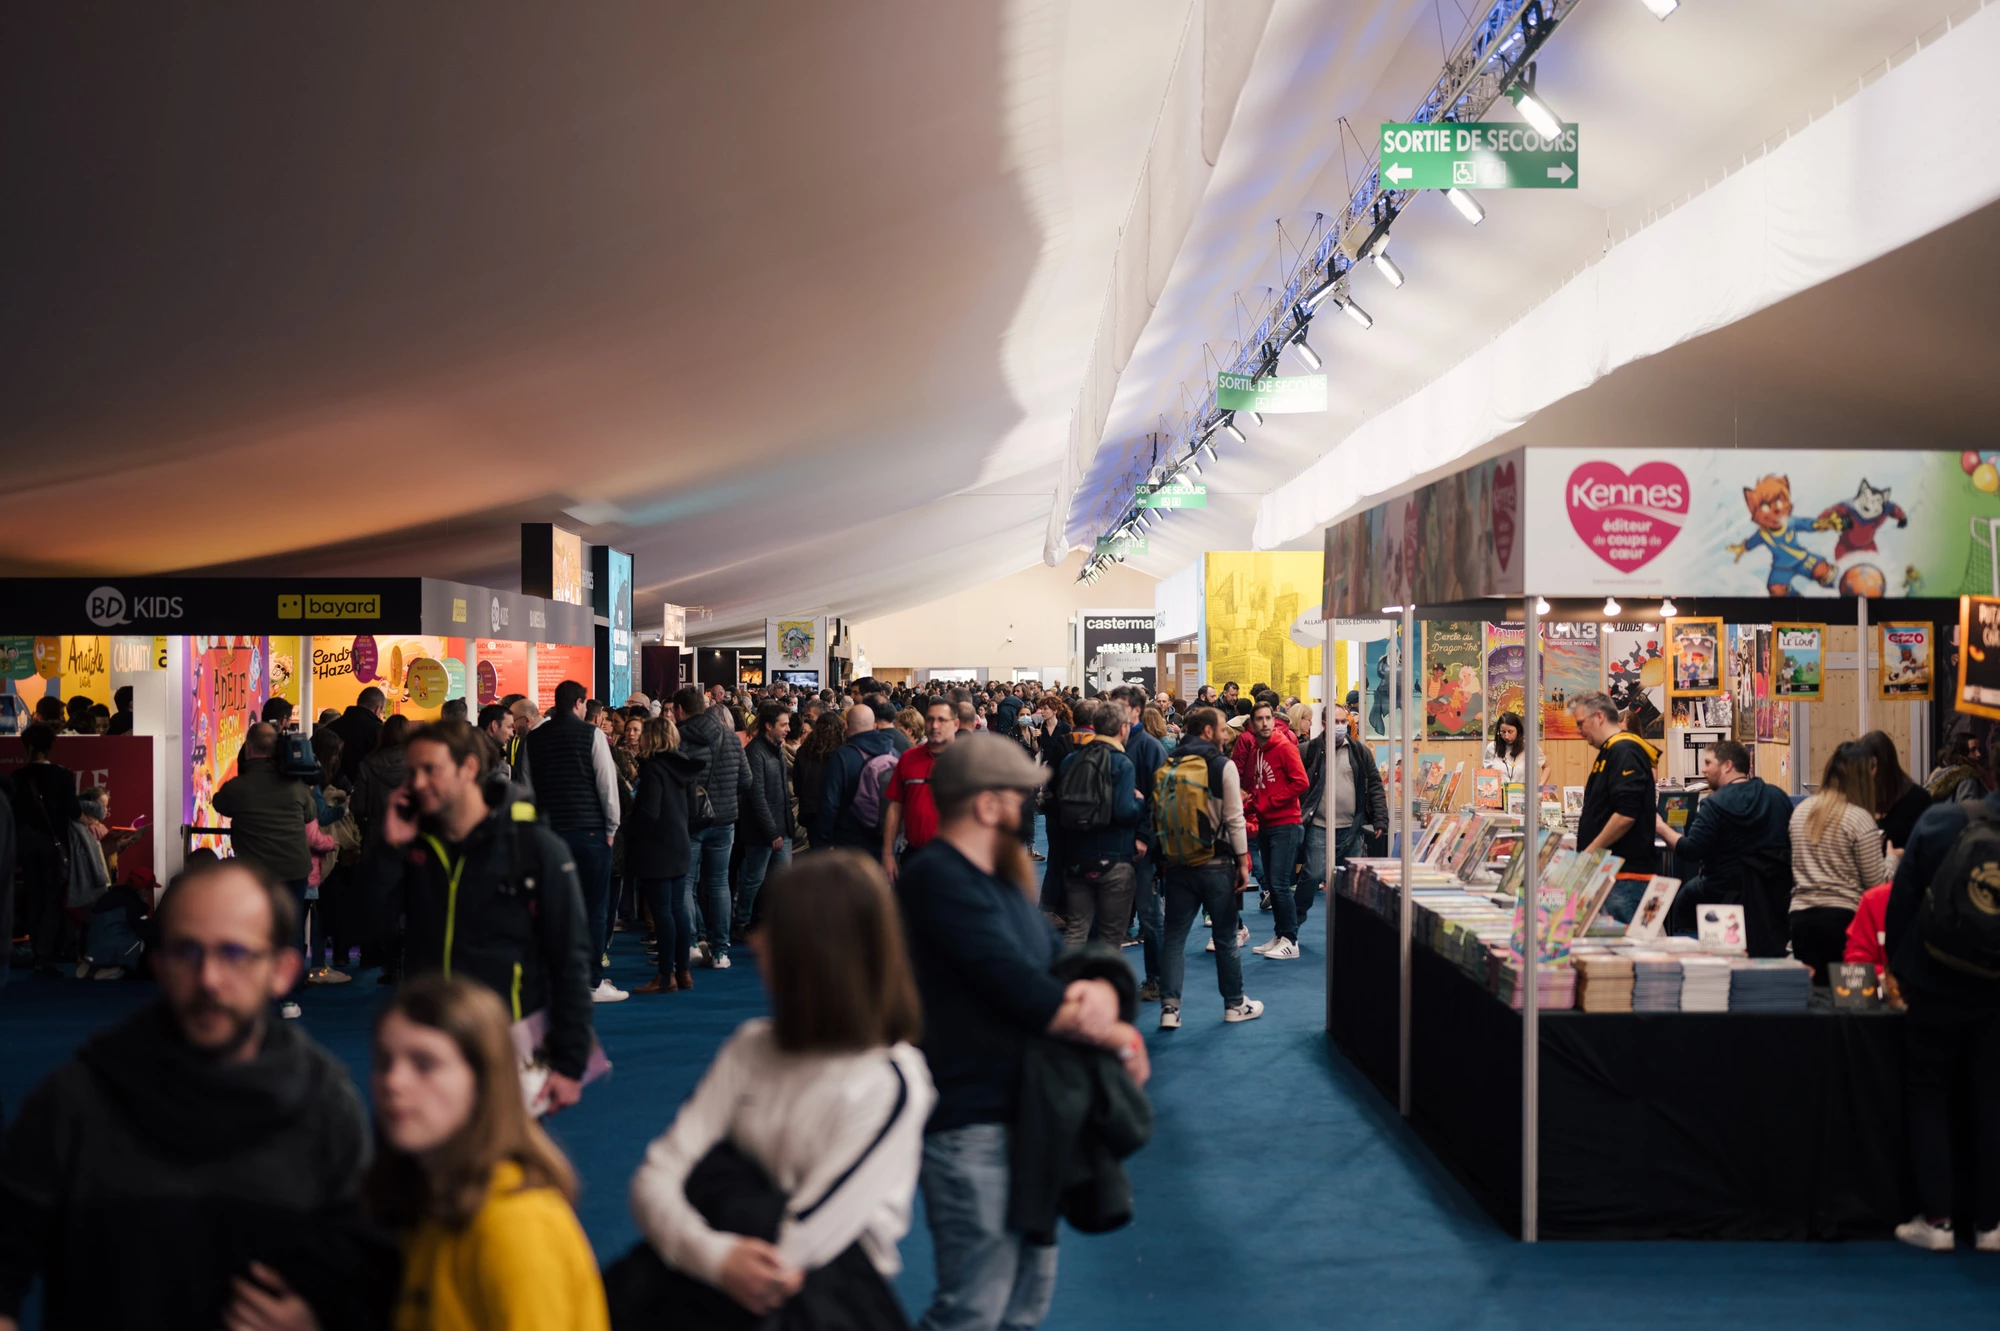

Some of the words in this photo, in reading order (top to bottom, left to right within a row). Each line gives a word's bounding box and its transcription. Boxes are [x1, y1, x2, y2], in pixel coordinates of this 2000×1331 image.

[1384, 130, 1450, 153] SORTIE
[1456, 130, 1481, 152] DE
[1487, 129, 1576, 152] SECOURS
[1258, 380, 1272, 392] DE
[1275, 378, 1326, 392] SECOURS
[1162, 486, 1172, 494] DE
[1173, 486, 1206, 495] SECOURS
[1572, 477, 1682, 511] Kennes
[1602, 518, 1653, 533] éditeur
[1606, 534, 1648, 548] coups
[92, 597, 123, 618] BD
[134, 597, 184, 618] KIDS
[310, 598, 375, 617] bayard
[1086, 617, 1156, 630] casterma
[1462, 632, 1474, 640] du
[1795, 638, 1814, 648] LOUP
[68, 635, 104, 676] Anatole
[313, 647, 353, 665] Cendr
[1430, 642, 1478, 655] Dragon-Thé
[113, 643, 151, 673] CALAMITY
[319, 663, 353, 680] Haze
[213, 667, 247, 712] ADÈLE
[219, 713, 240, 738] SHOW
